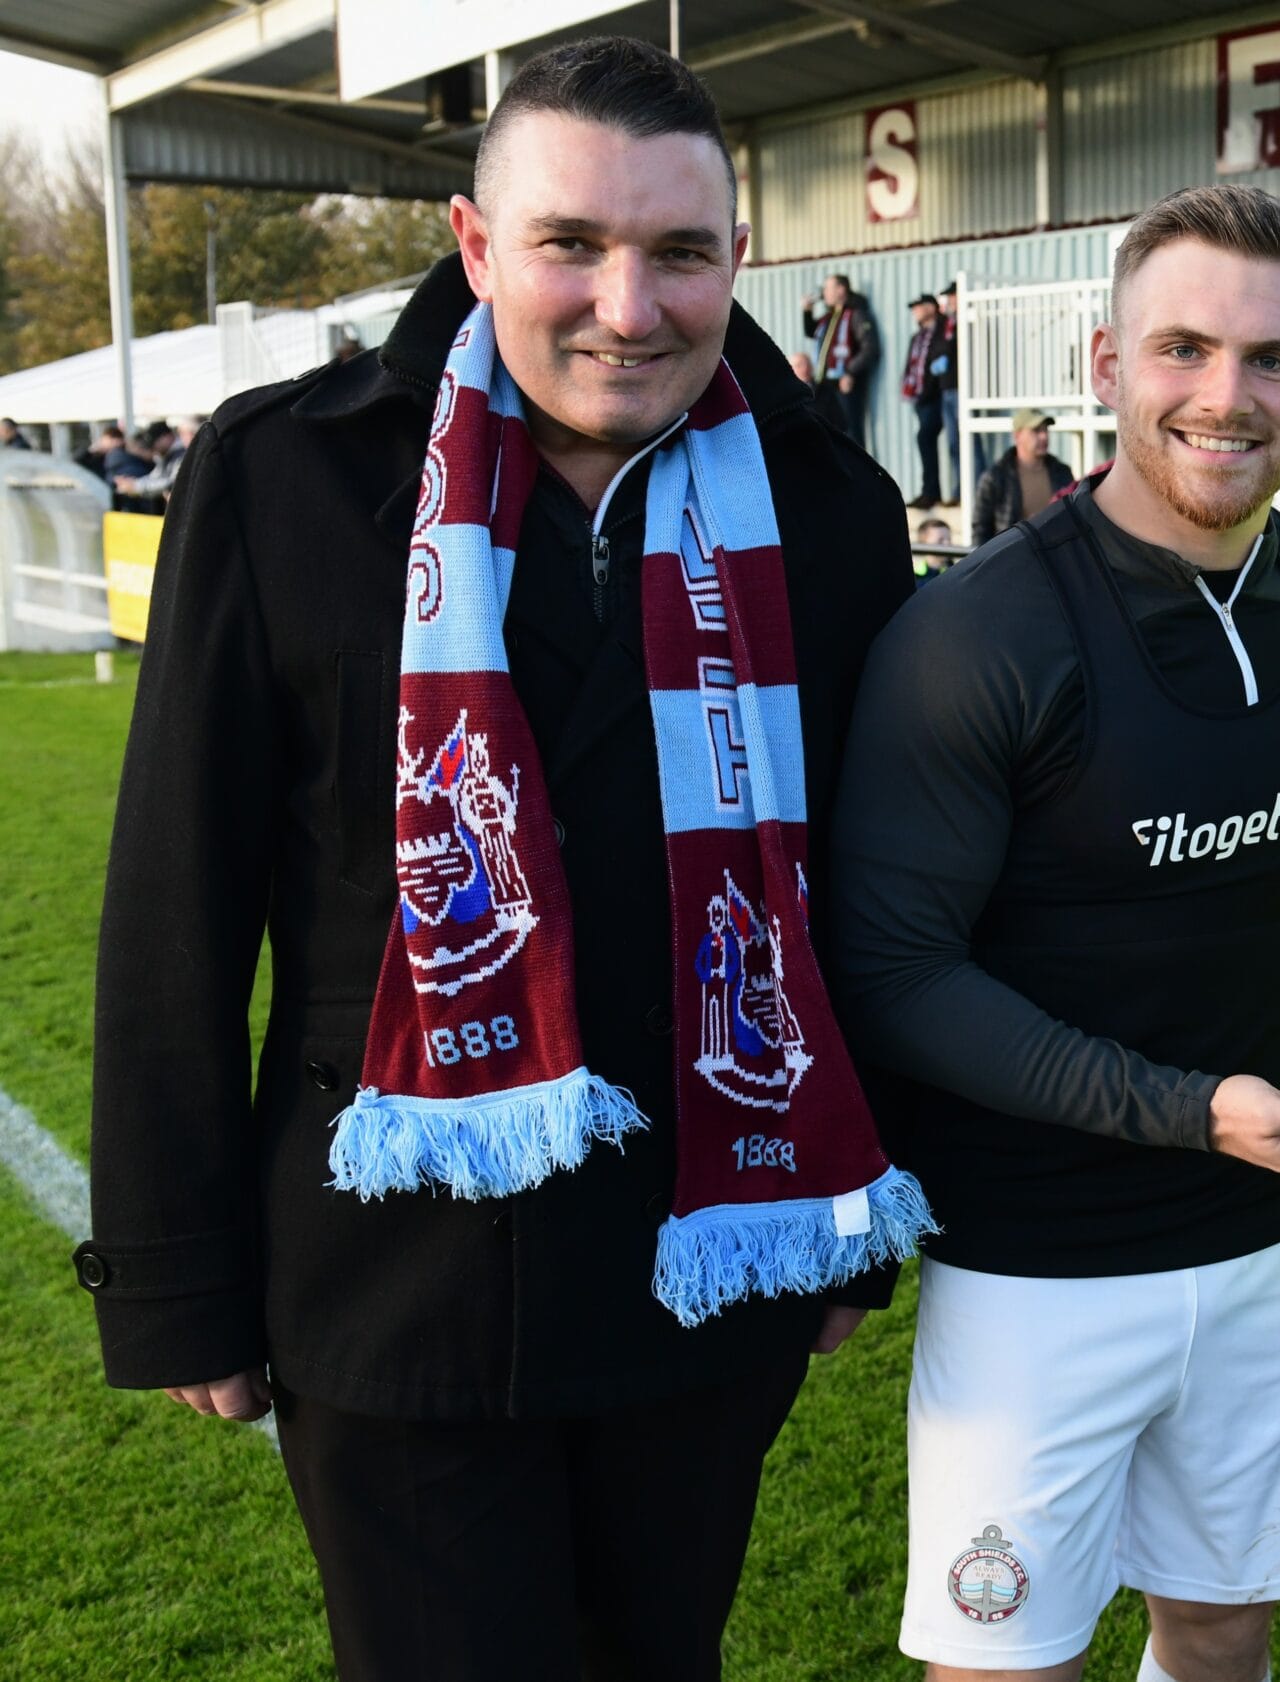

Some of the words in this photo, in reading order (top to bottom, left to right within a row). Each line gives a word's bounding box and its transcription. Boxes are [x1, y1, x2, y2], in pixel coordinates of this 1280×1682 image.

[868, 109, 918, 218] S
[423, 1015, 519, 1068] 1888
[954, 1551, 977, 1575] SOUTH
[978, 1549, 1016, 1567] SHIELDS
